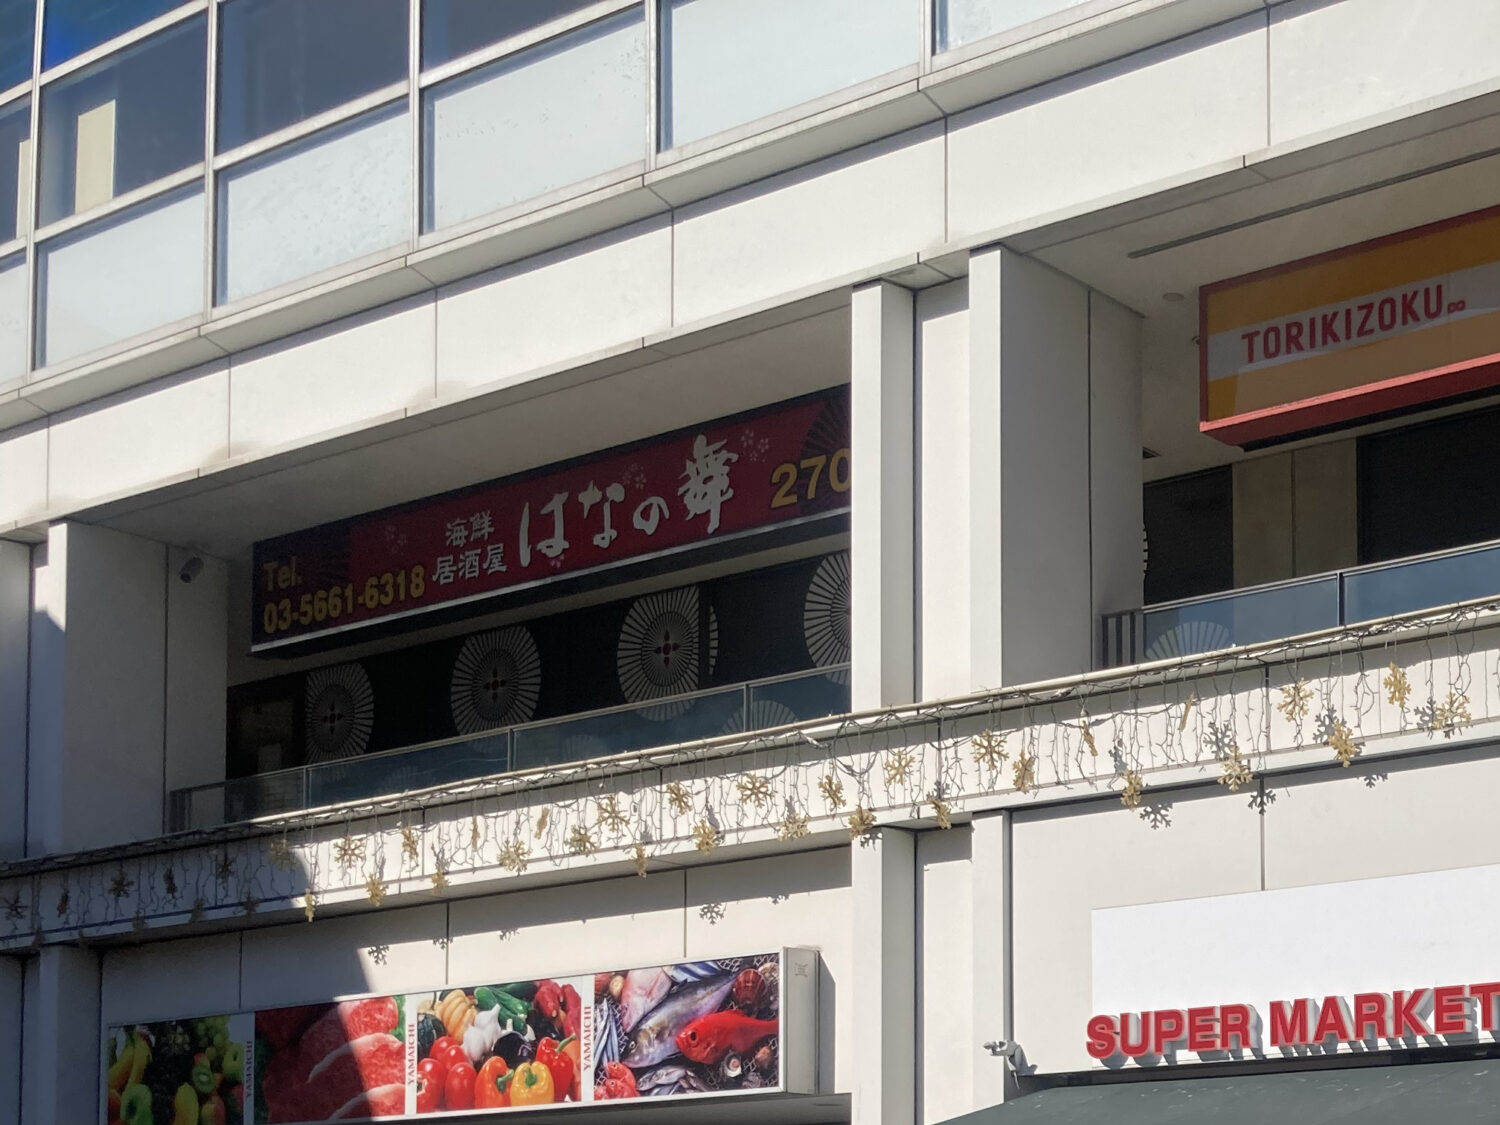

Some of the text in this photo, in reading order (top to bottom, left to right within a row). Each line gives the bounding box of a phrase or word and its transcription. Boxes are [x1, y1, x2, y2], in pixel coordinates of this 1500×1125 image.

[1241, 284, 1444, 366] TORIKIZOKU
[771, 448, 852, 508] 270
[445, 509, 495, 547] 海鮮
[432, 543, 508, 585] 居酒屋
[263, 564, 426, 634] 03-5661-6318
[408, 1023, 416, 1085] YAMAICHI
[584, 1006, 592, 1071] YAMAICHI
[1086, 1003, 1253, 1060] SUPER
